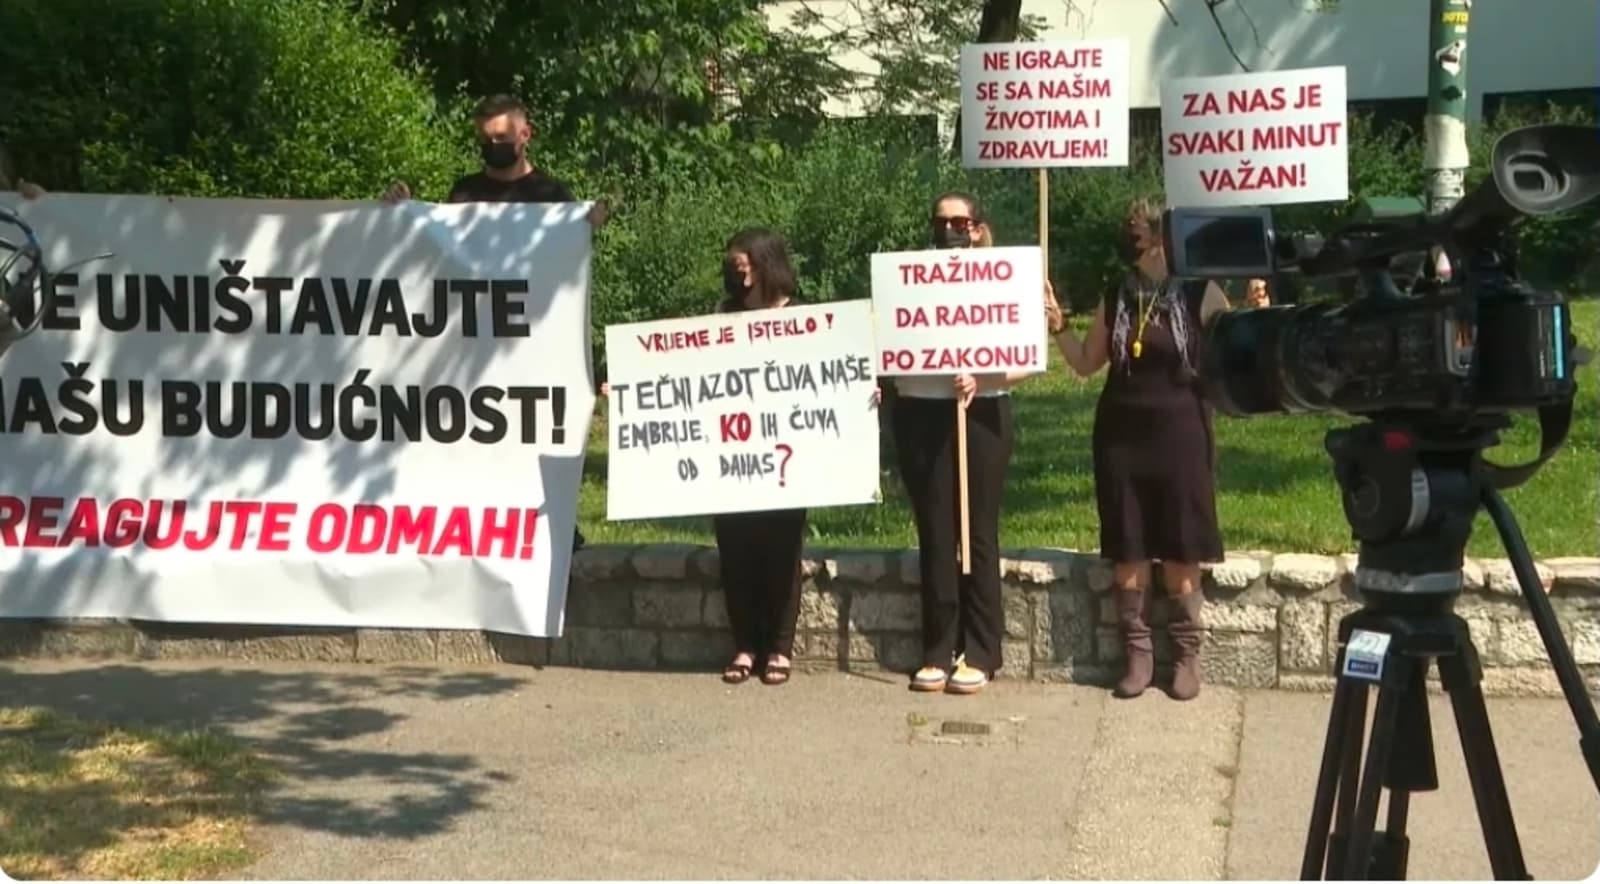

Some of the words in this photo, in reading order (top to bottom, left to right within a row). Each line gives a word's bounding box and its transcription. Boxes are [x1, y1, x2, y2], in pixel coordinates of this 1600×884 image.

[983, 51, 1009, 71] NE
[1016, 49, 1102, 69] IGRAJTE
[976, 81, 998, 100] SE
[1004, 80, 1032, 99] SA
[1039, 73, 1111, 99] NAŠIM
[1182, 92, 1220, 117] ZA
[1228, 88, 1286, 114] NAS
[1293, 84, 1321, 108] JE
[985, 105, 1089, 131] ŽIVOTIMA
[1095, 109, 1101, 129] I
[979, 139, 1108, 160] ZDRAVLJEM!
[1168, 129, 1244, 155] SVAKI
[1252, 122, 1342, 149] MINUT
[1200, 160, 1306, 191] VAŽAN!
[899, 256, 1012, 285] TRAŽIMO
[97, 259, 531, 338] UNIŠTAVAJTE
[896, 308, 929, 327] DA
[936, 304, 1019, 326] RADITE
[637, 330, 710, 352] VRIJEME
[716, 326, 735, 344] JE
[748, 318, 817, 343] ISTEKLO
[882, 350, 914, 371] PO
[922, 345, 1037, 370] ZAKONU!
[698, 367, 759, 403] AZOT
[764, 360, 818, 399] ČUVA
[821, 354, 872, 391] NAŠE
[162, 370, 567, 445] BUDUĆNOST!
[720, 412, 752, 443] KO
[761, 412, 779, 439] IH
[790, 404, 840, 438] ČUVA
[678, 457, 699, 482] OD
[0, 496, 298, 554] REAGUJTE
[306, 503, 538, 561] ODMAH!
